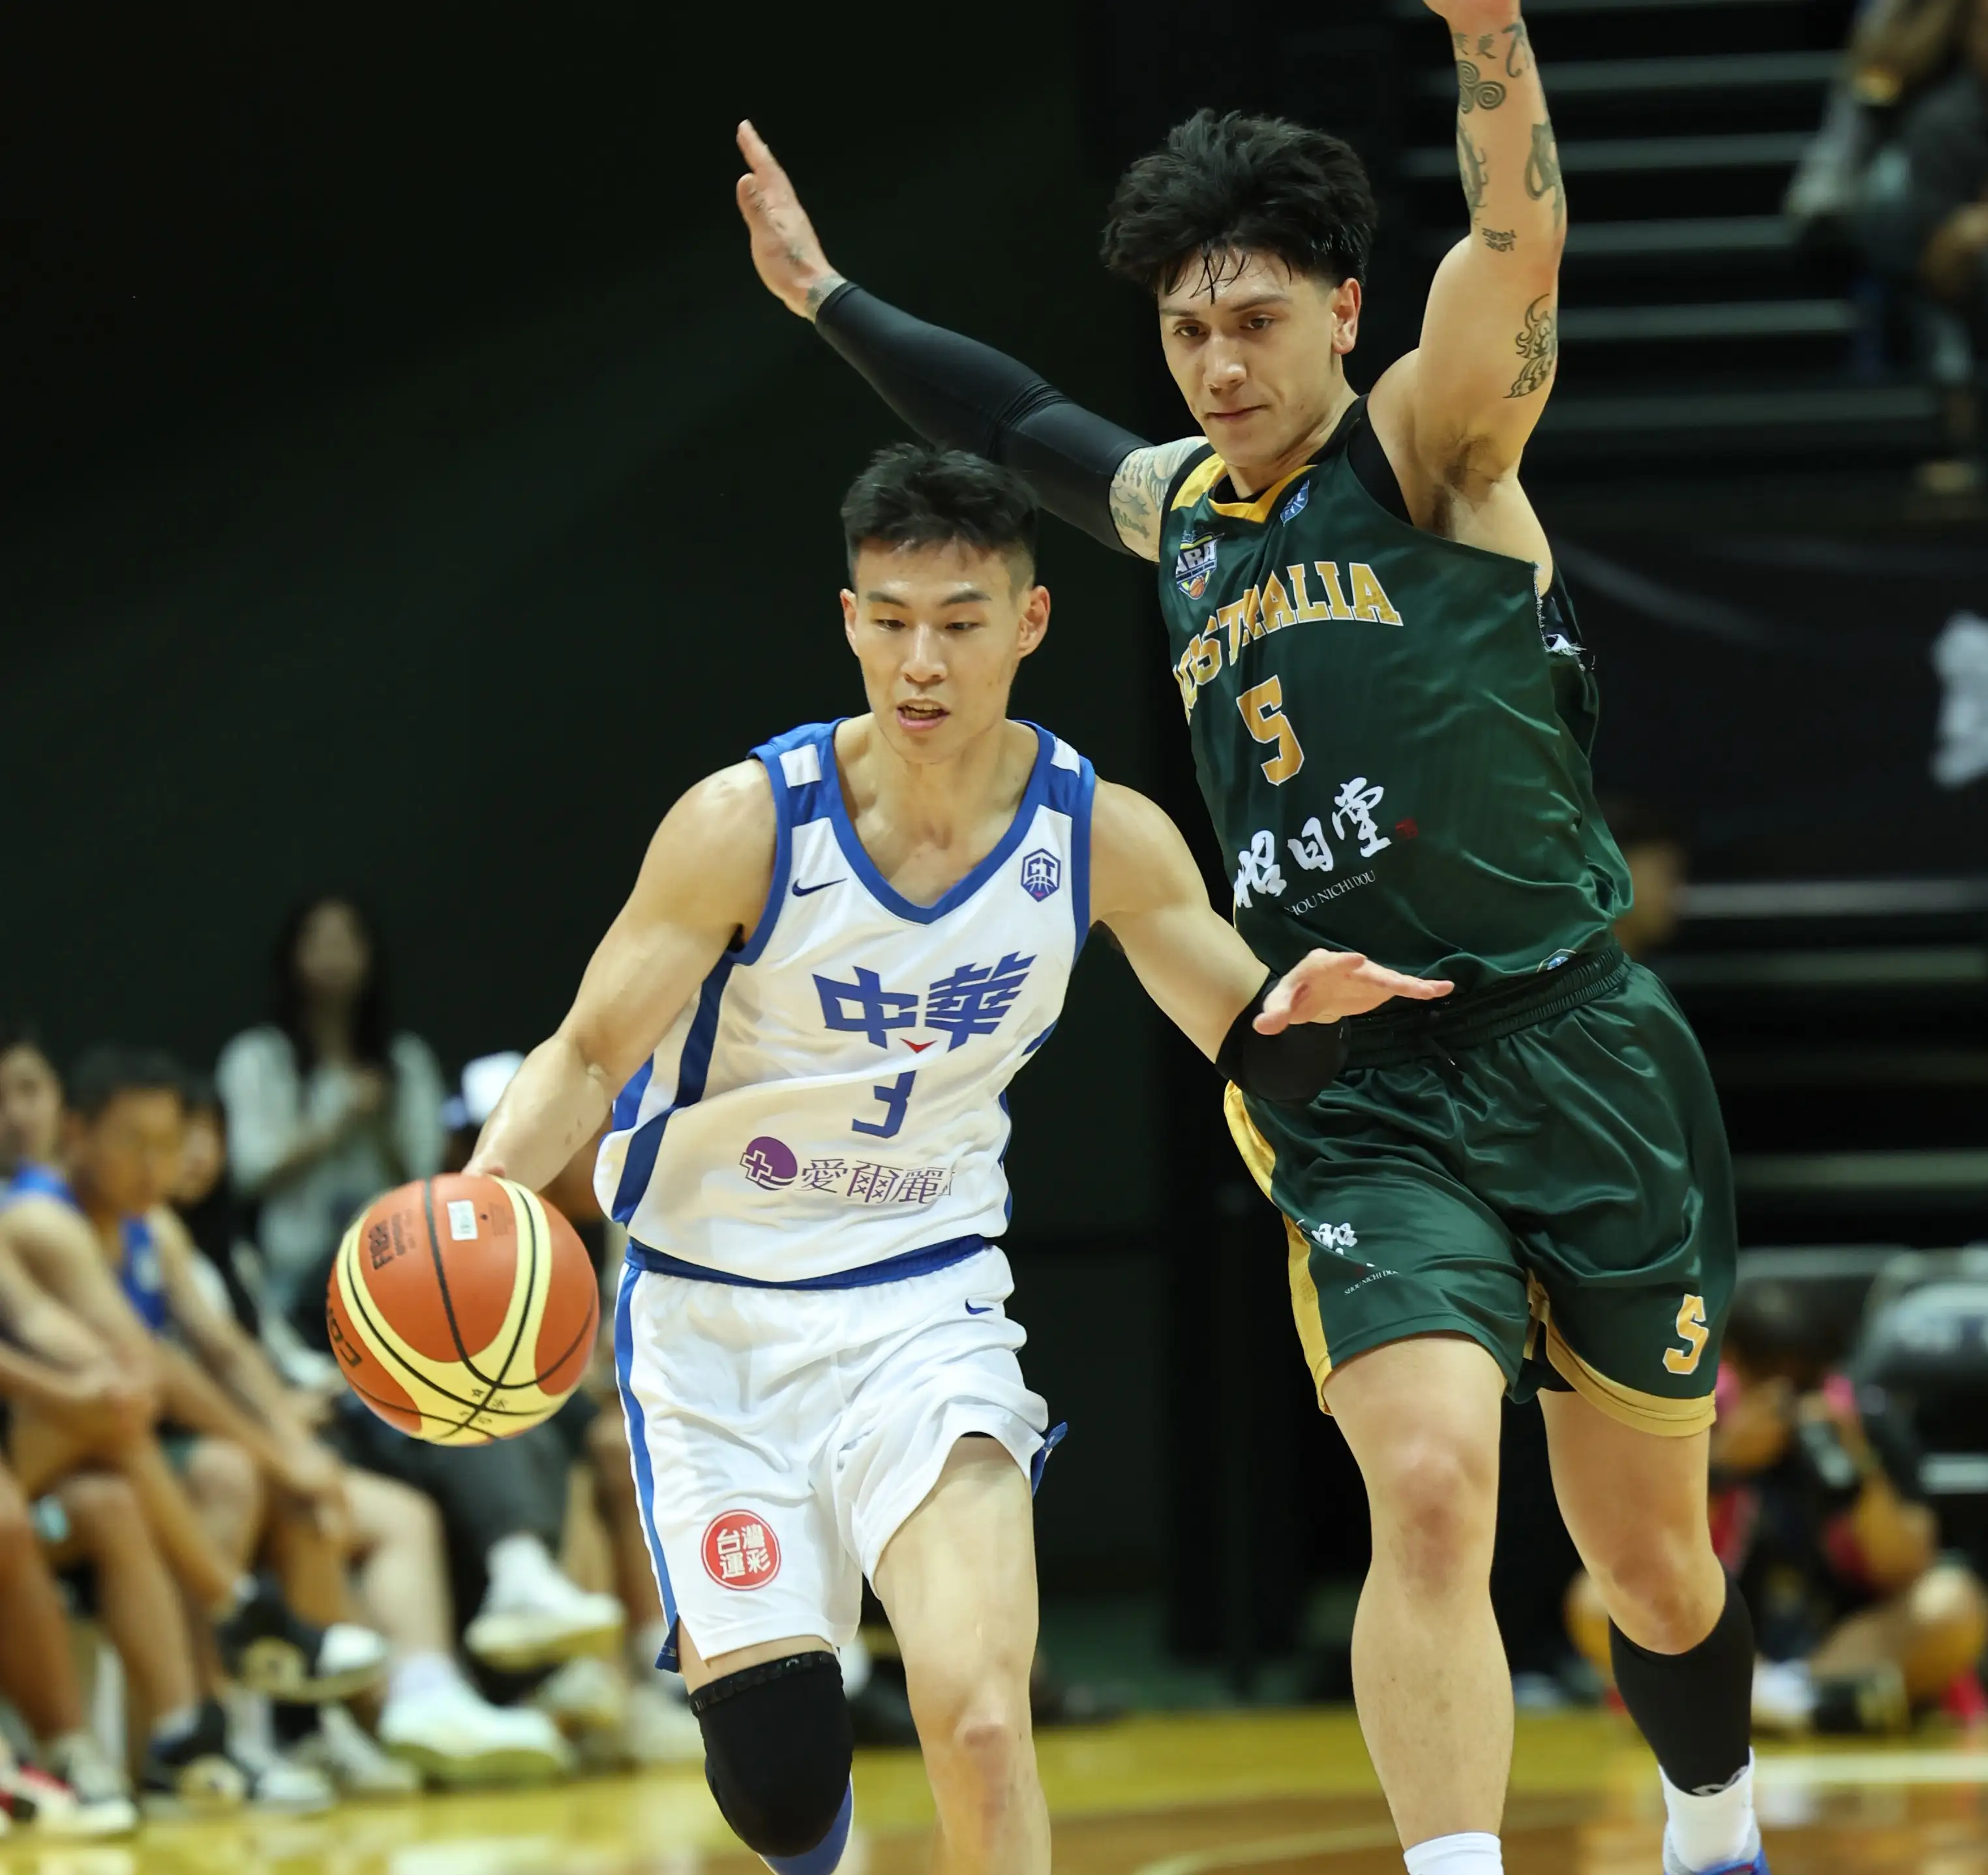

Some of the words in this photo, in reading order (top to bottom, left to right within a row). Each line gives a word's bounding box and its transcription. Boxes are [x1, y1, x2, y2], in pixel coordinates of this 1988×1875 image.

[1236, 674, 1304, 787] 5
[812, 951, 1038, 1052] 中華
[1662, 1292, 1709, 1375] 5
[716, 1523, 765, 1555] 台灣
[719, 1549, 771, 1579] 運彩
